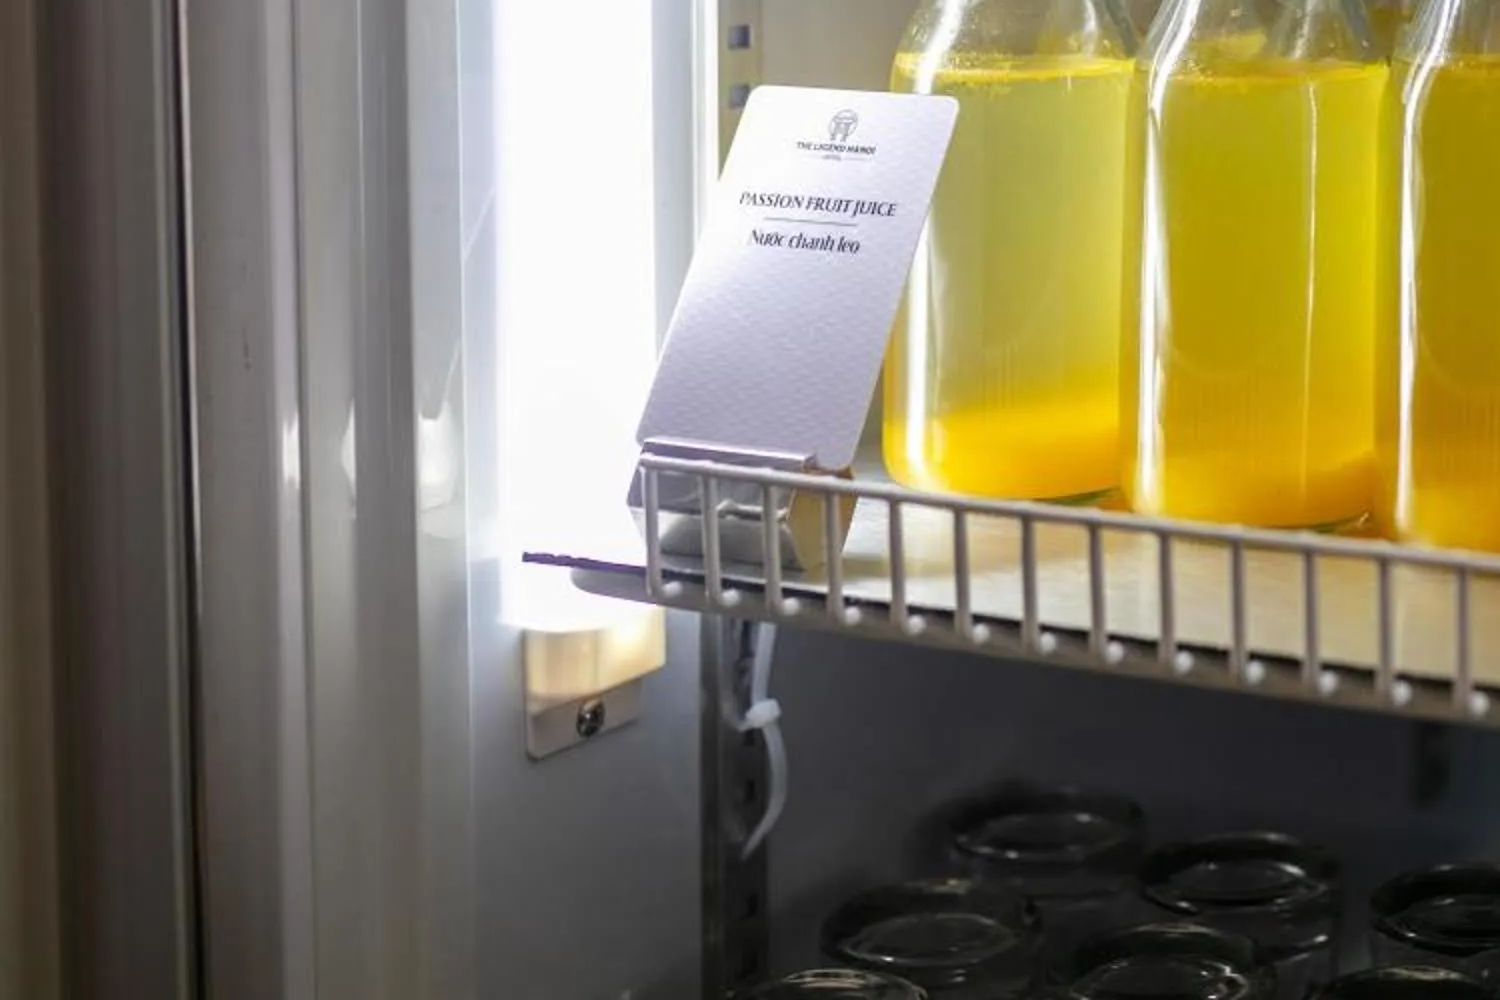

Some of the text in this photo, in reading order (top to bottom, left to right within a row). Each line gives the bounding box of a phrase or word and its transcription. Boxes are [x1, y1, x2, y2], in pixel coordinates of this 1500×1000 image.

[739, 191, 897, 218] PASSION FRUIT JUICE
[788, 231, 835, 252] chanh
[836, 235, 861, 254] leo
